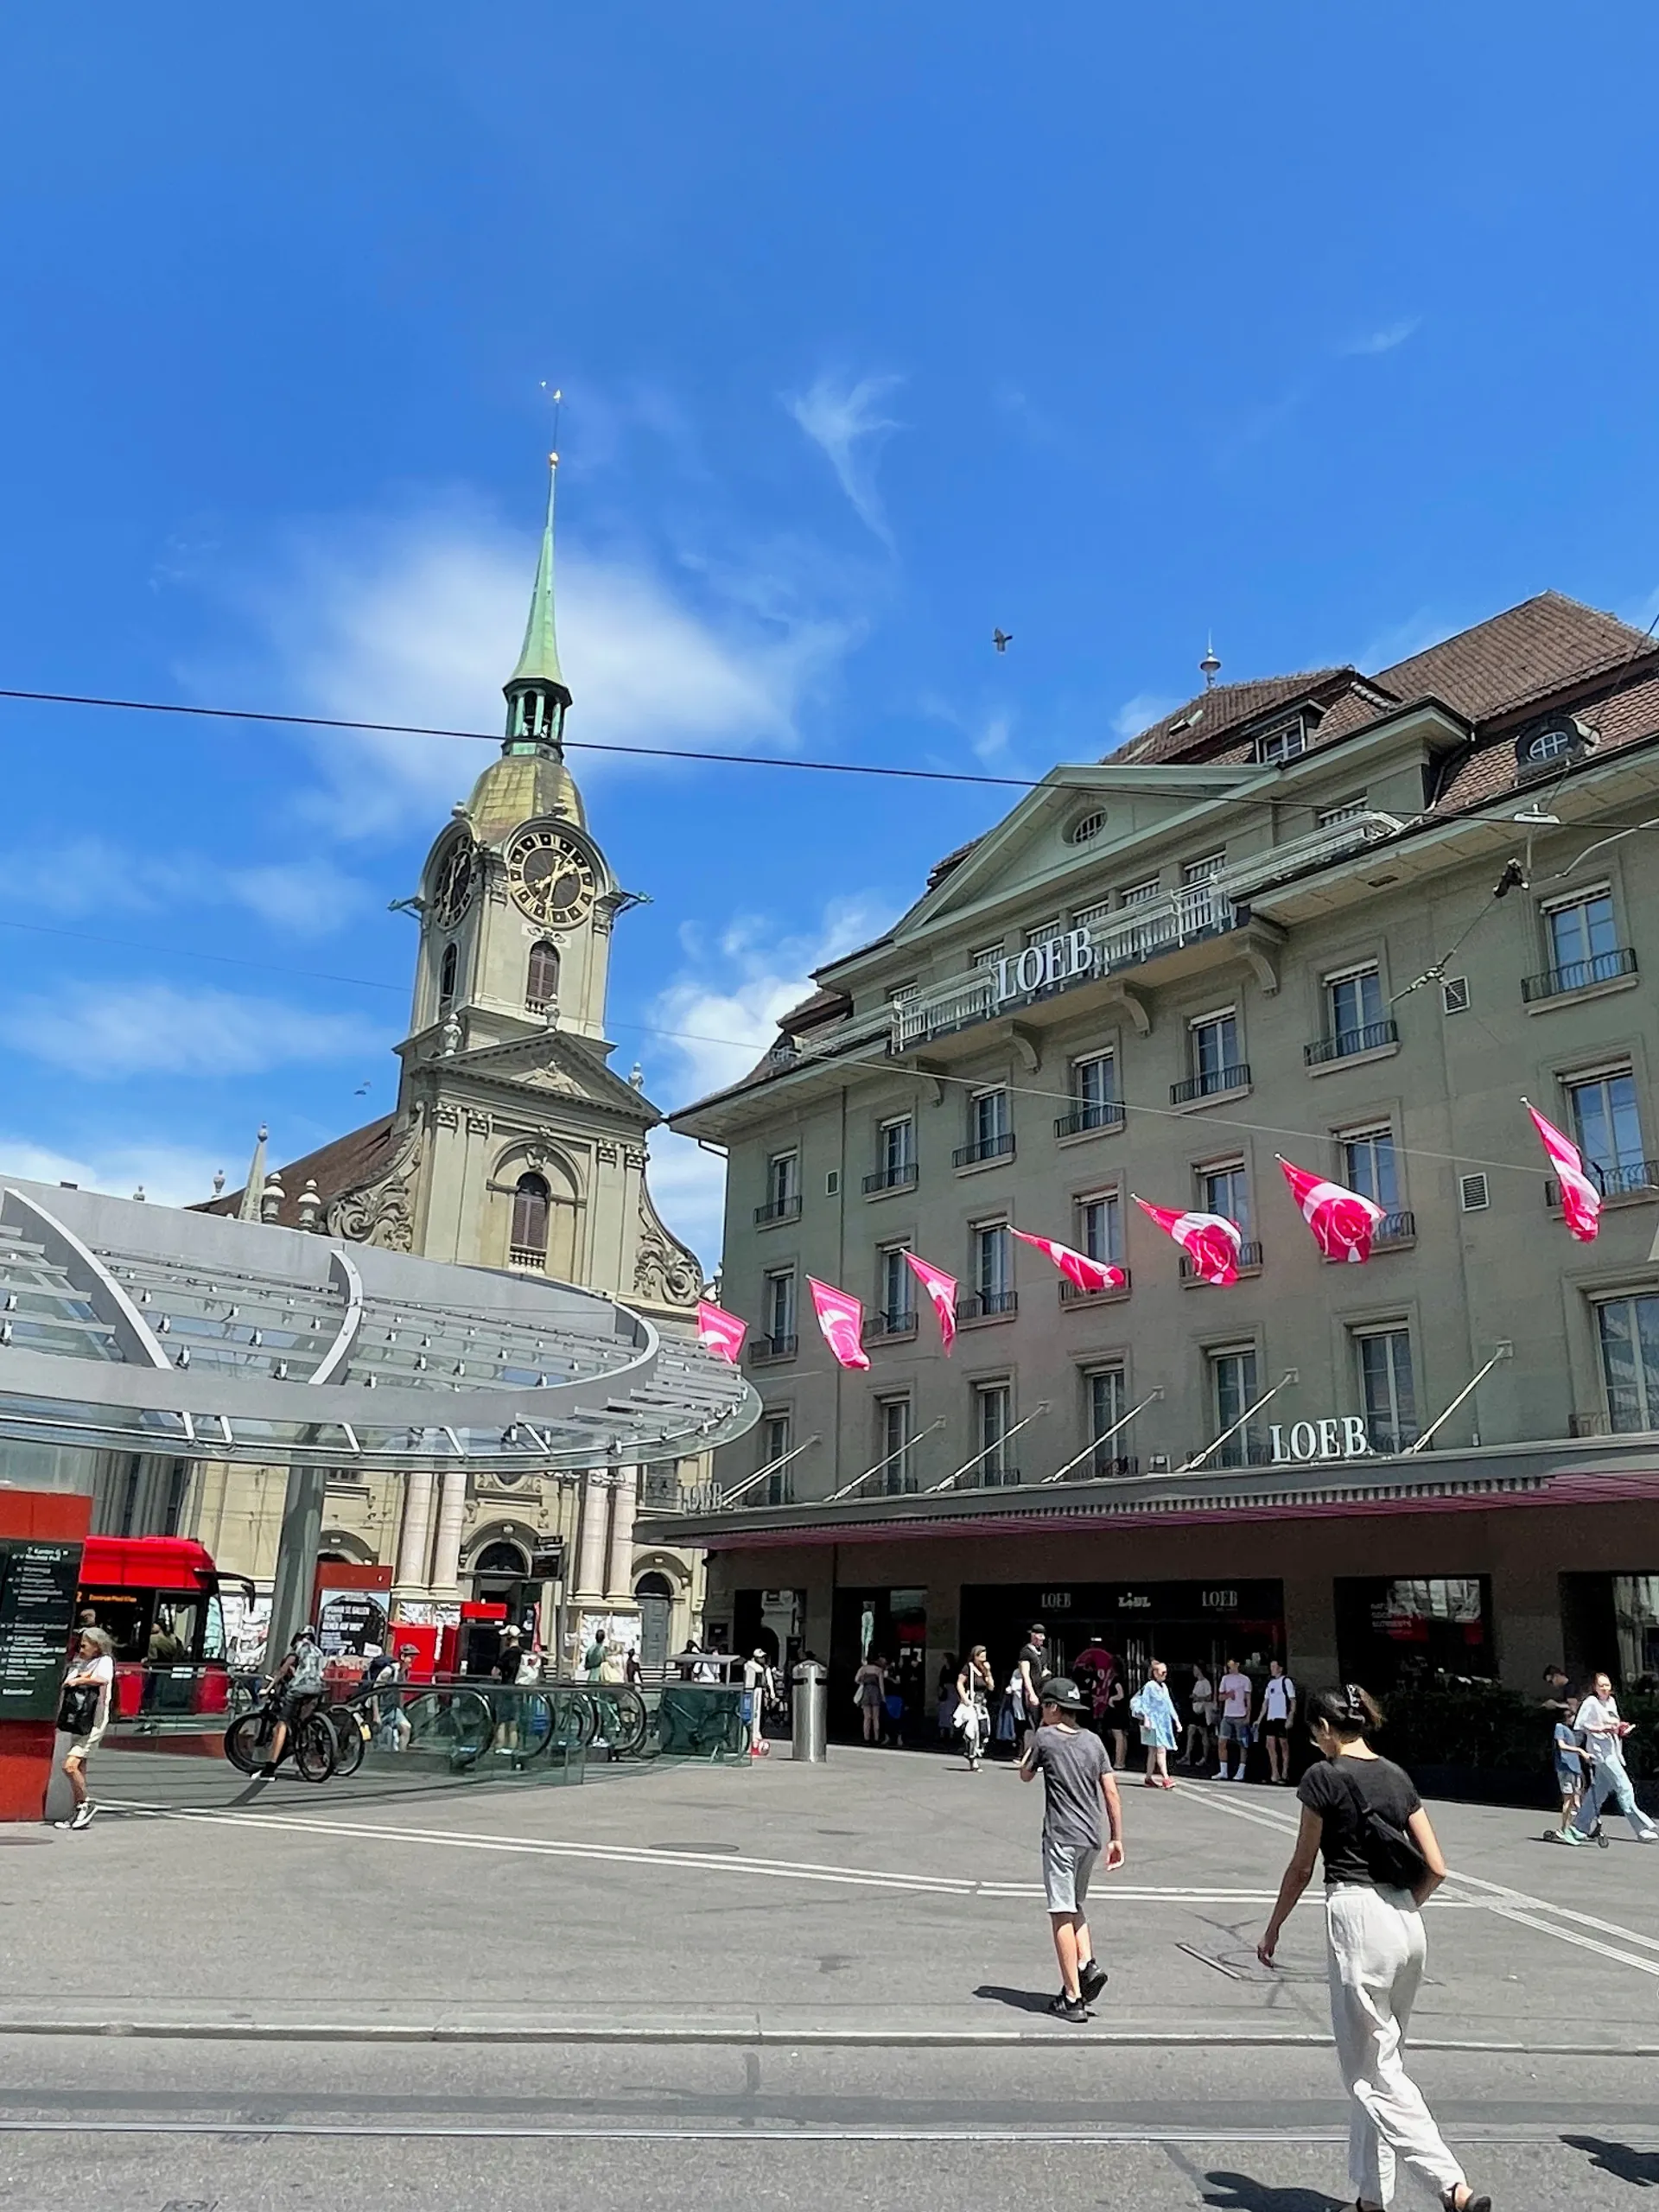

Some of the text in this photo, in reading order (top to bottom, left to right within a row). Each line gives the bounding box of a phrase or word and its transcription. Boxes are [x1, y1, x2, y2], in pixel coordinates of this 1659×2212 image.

[989, 927, 1093, 1003] LOEB
[1268, 1416, 1367, 1463] LOEB
[1041, 1592, 1071, 1608] LOEB
[1202, 1591, 1238, 1607] LOEB
